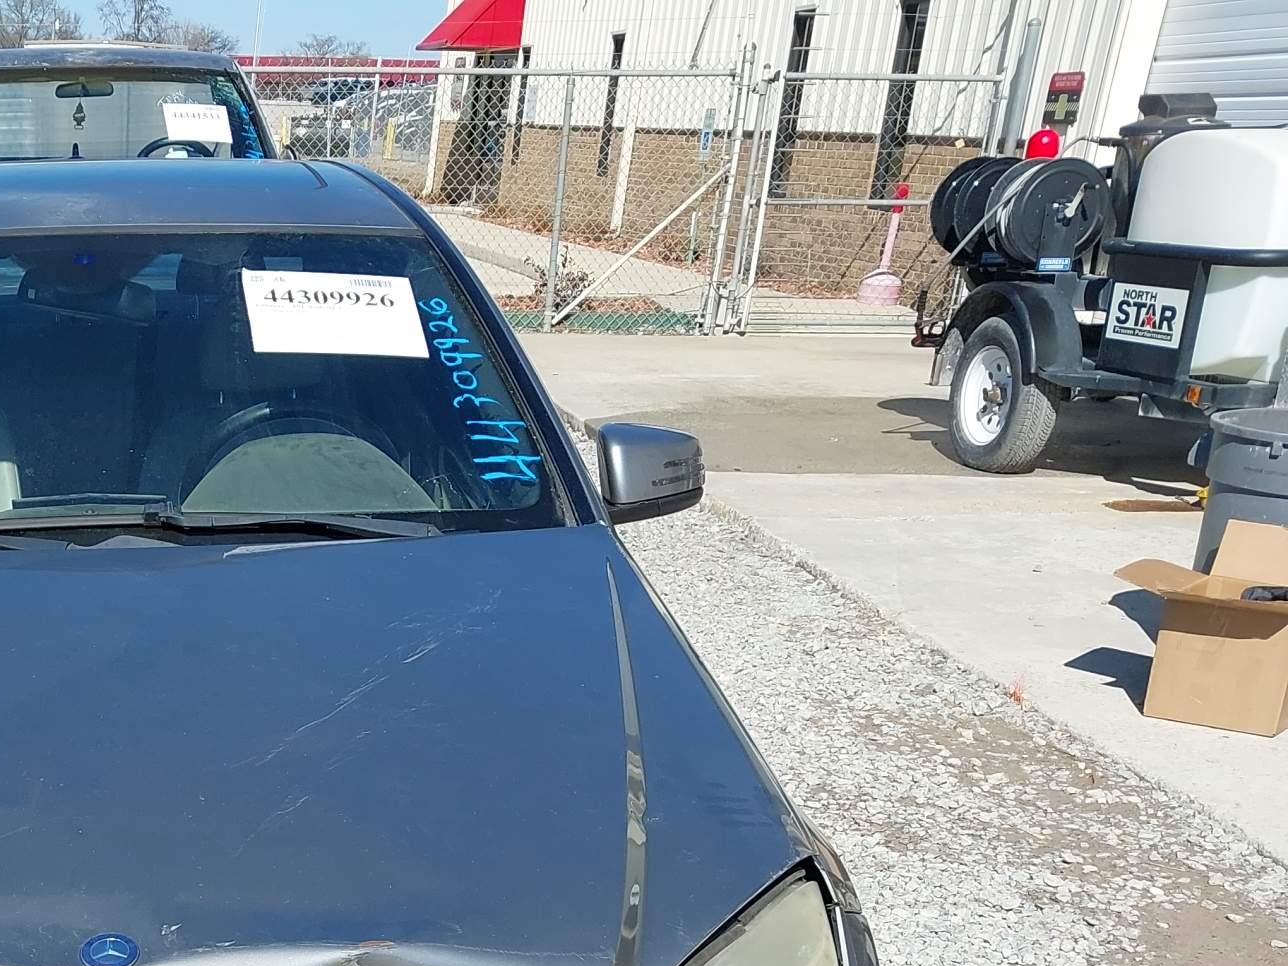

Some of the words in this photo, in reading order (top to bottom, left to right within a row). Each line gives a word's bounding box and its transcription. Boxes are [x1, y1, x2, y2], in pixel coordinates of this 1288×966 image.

[264, 288, 394, 307] 44309926
[1122, 288, 1158, 302] NORTH
[1115, 299, 1177, 332] STAR
[418, 297, 541, 482] 44309926
